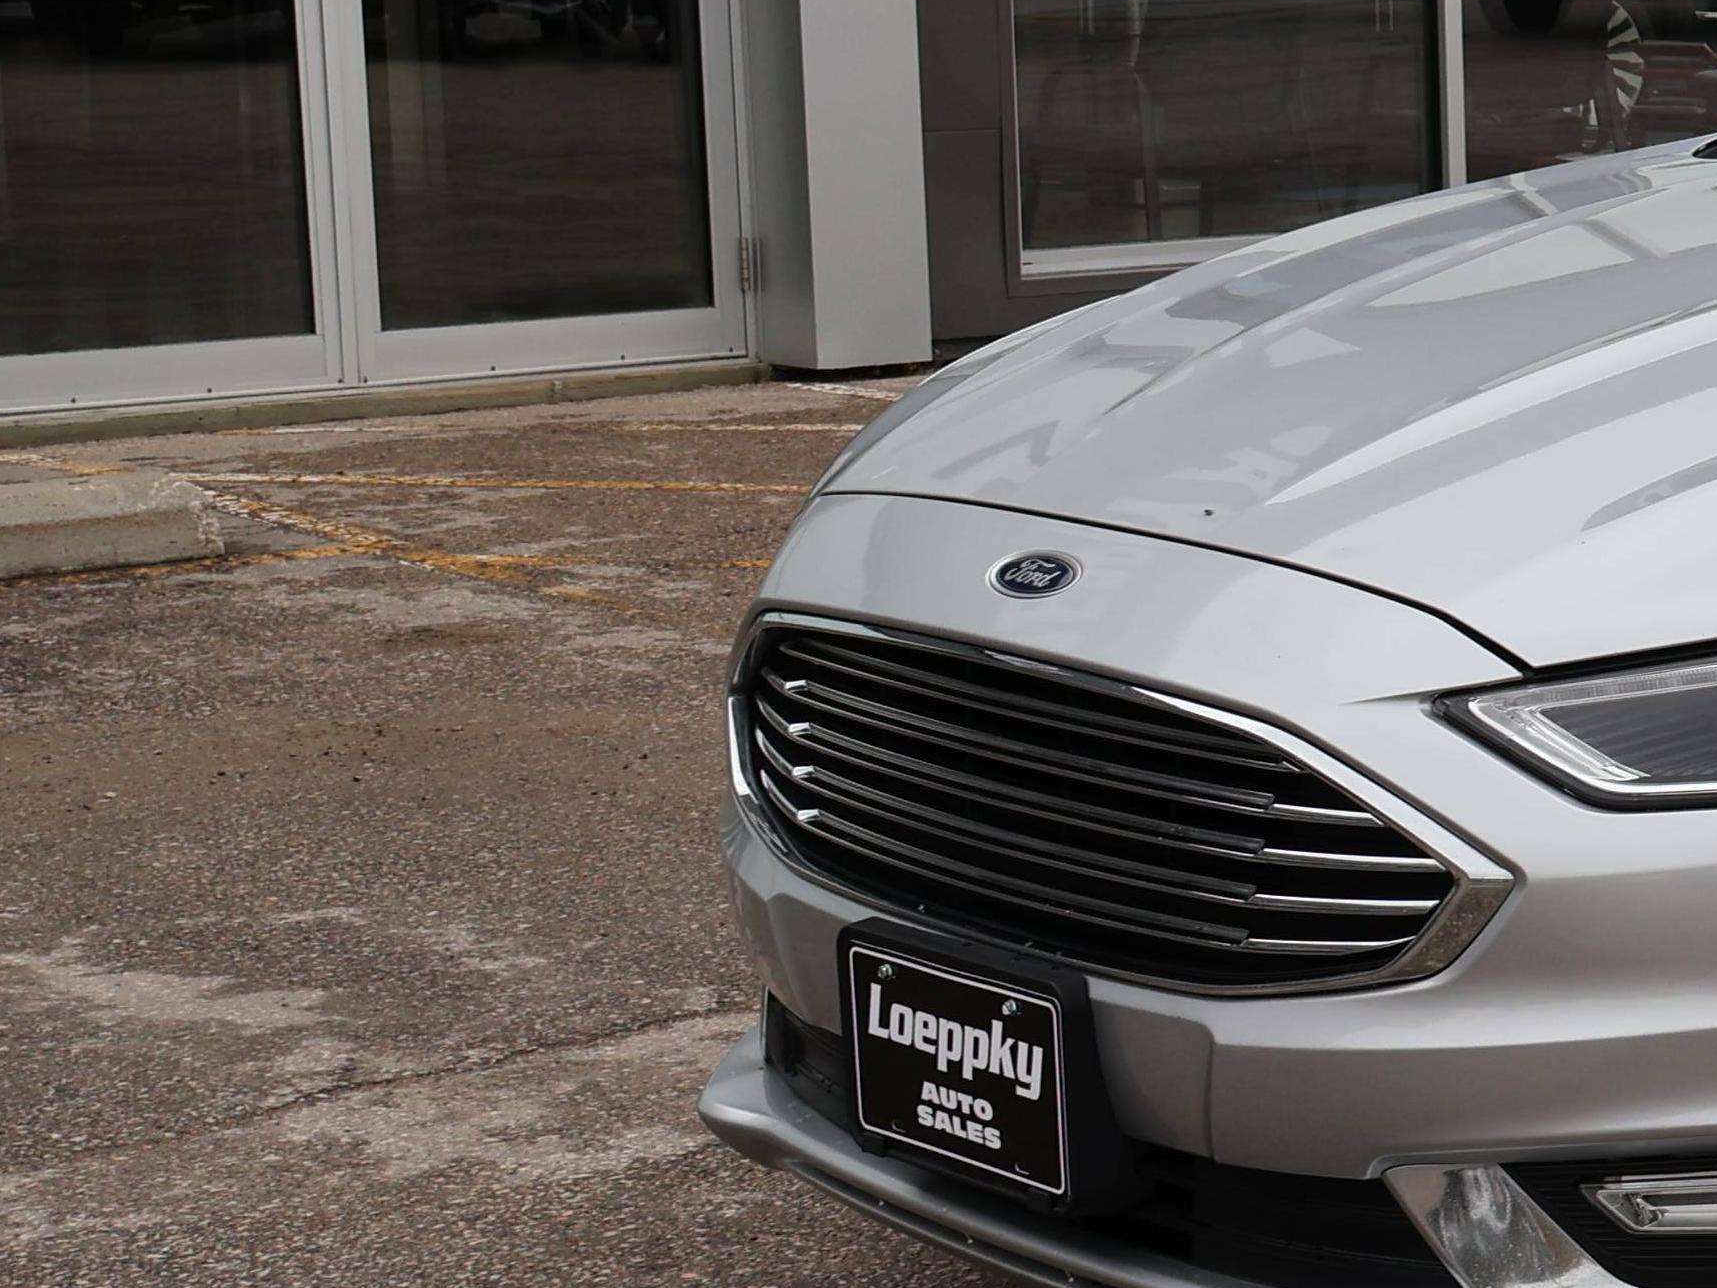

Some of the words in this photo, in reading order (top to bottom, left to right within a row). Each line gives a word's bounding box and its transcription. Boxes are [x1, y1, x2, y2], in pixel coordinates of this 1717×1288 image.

[1003, 558, 1061, 588] Ford
[868, 982, 1043, 1100] Loeppky
[921, 1081, 993, 1121] AUTO
[917, 1105, 1001, 1150] SALES
